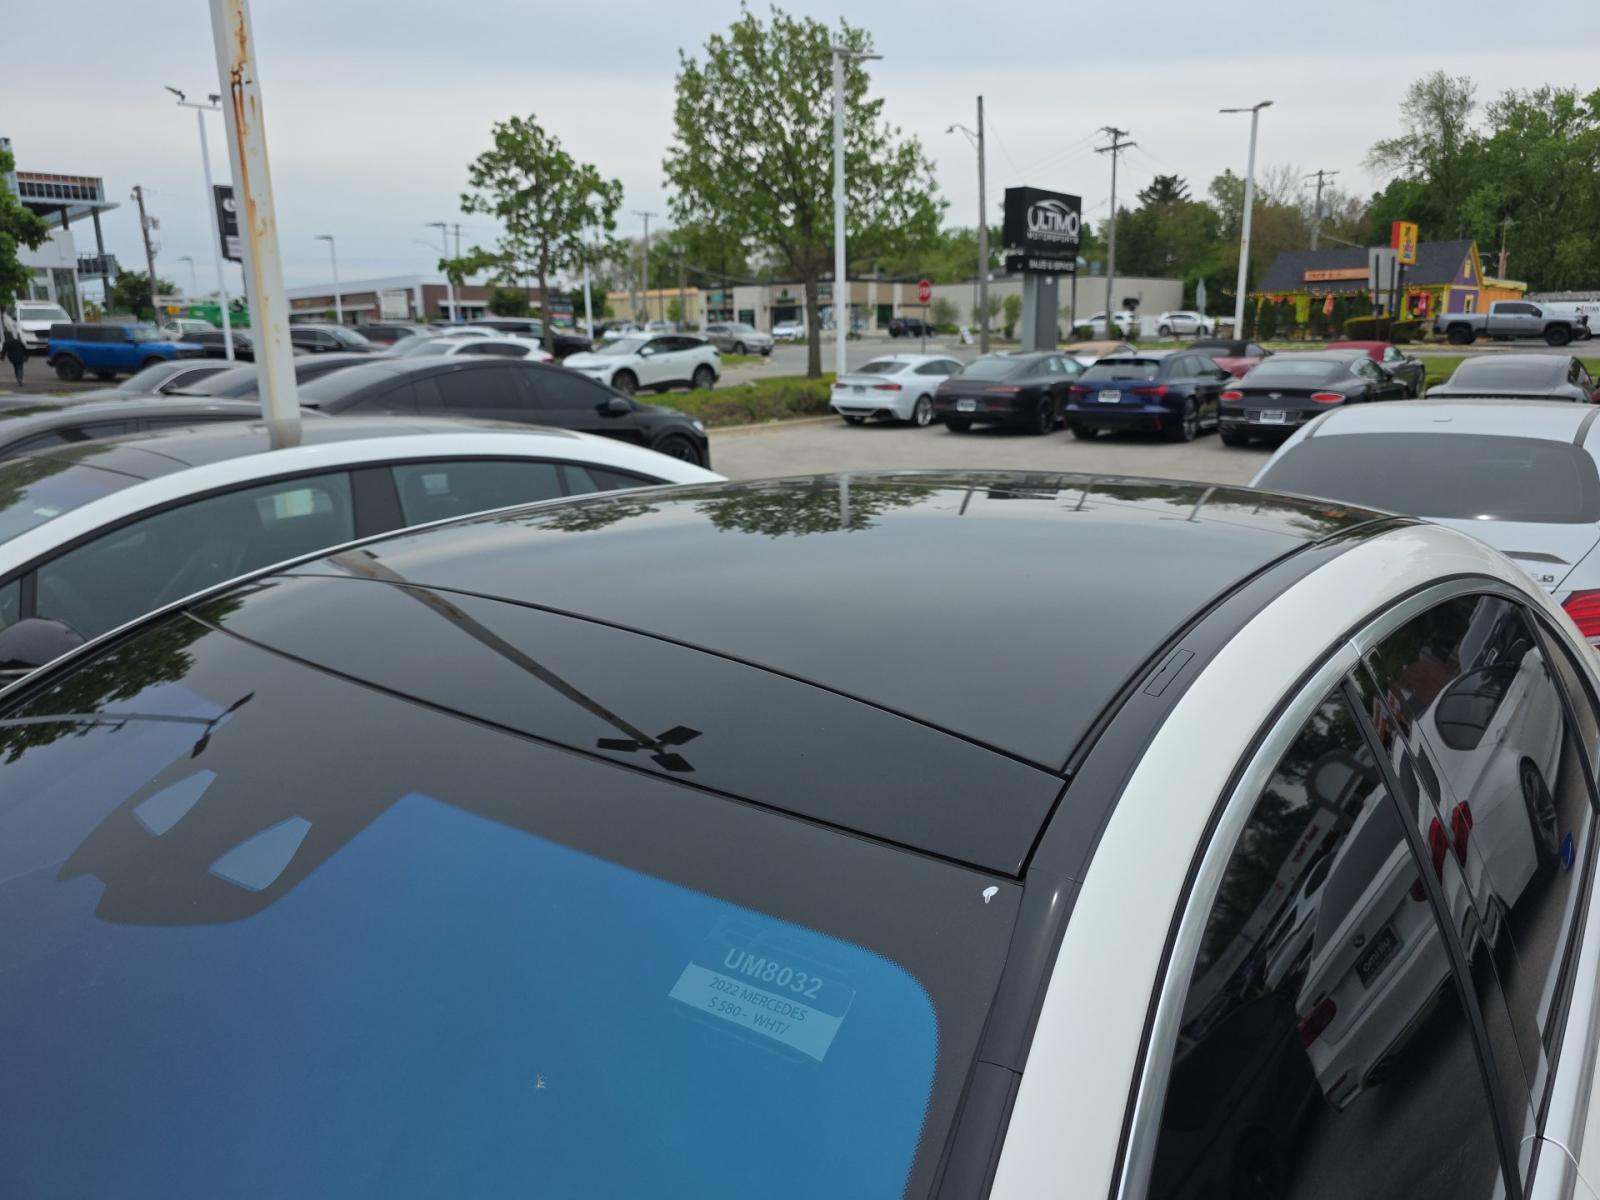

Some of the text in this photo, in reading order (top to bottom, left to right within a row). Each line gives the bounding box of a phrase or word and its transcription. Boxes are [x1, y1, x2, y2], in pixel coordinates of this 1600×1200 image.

[1027, 205, 1080, 236] ULTIMO
[725, 948, 823, 999] UM8032
[709, 977, 808, 1021] 2022 MERCEDES
[718, 1001, 741, 1017] 580
